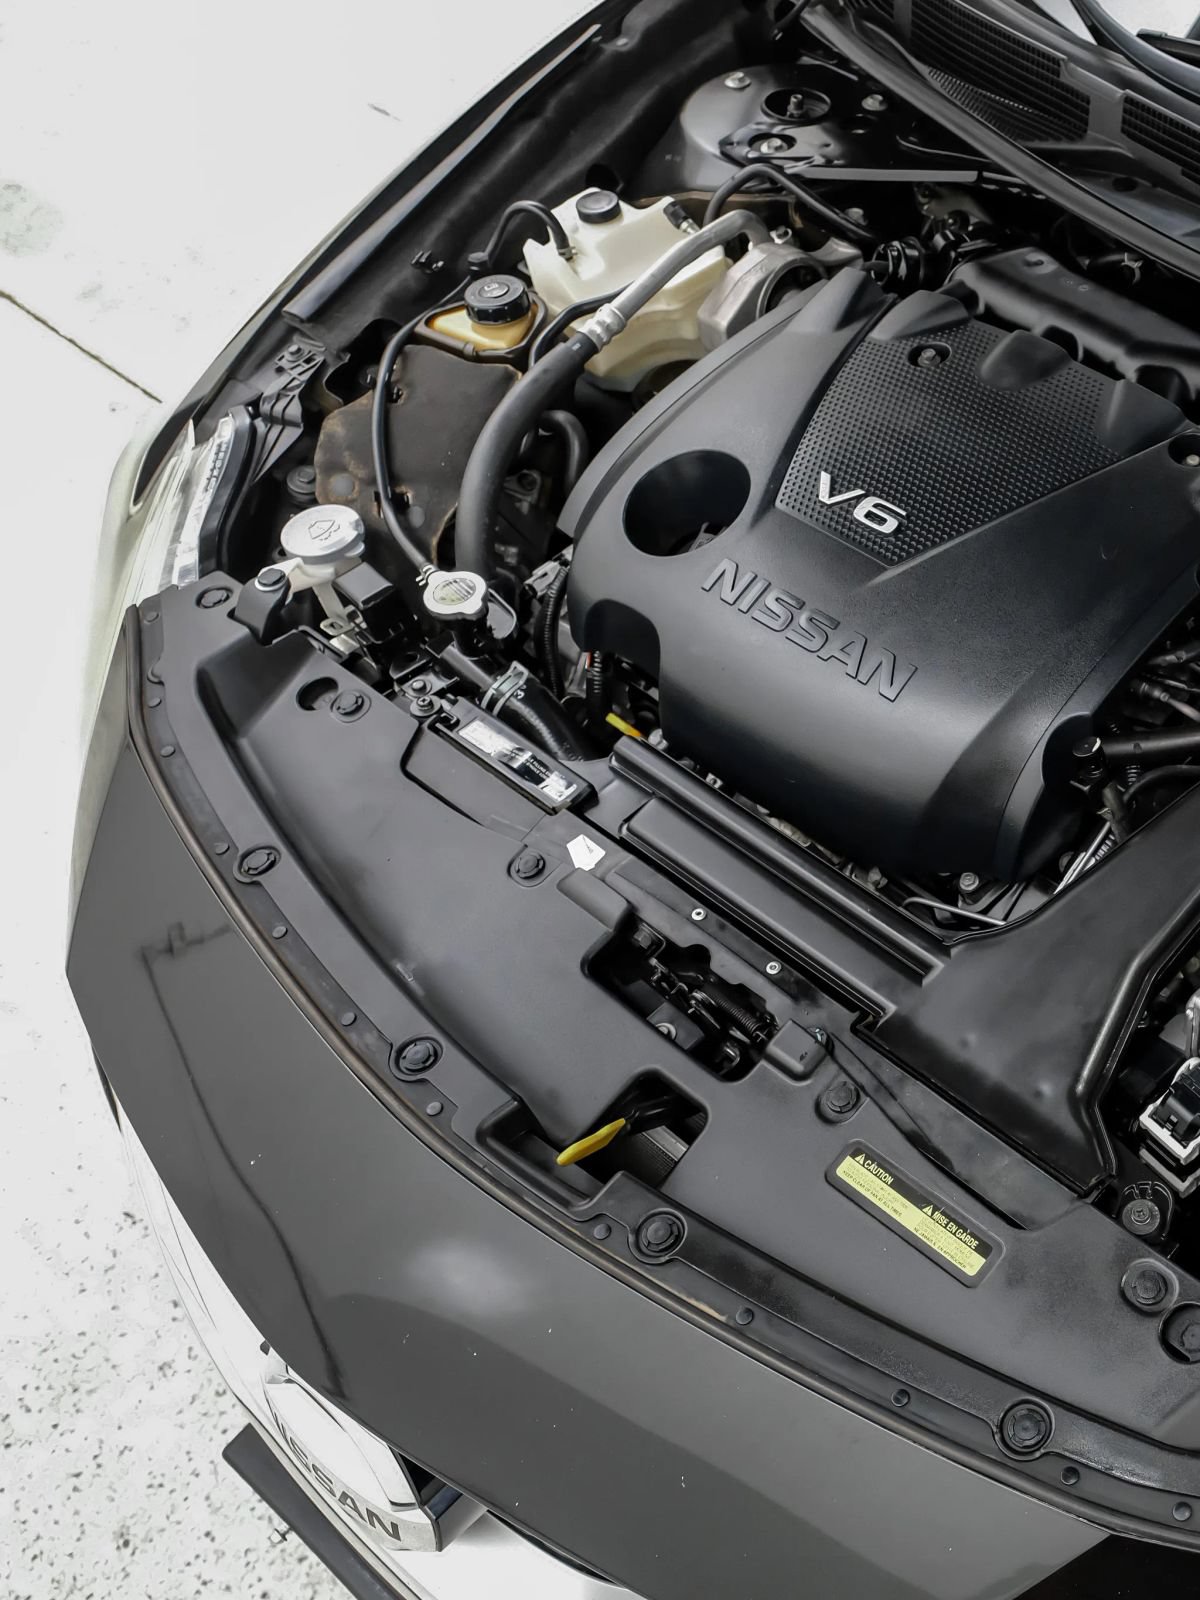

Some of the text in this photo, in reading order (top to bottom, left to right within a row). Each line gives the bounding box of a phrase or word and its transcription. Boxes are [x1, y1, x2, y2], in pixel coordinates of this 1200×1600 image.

[818, 470, 908, 535] V6
[701, 557, 919, 703] NISSAN
[852, 1177, 866, 1189] CLEAR
[863, 1159, 894, 1185] CAUTION
[931, 1211, 979, 1249] MISE EN GARDE
[272, 1410, 402, 1542] NISSAN
